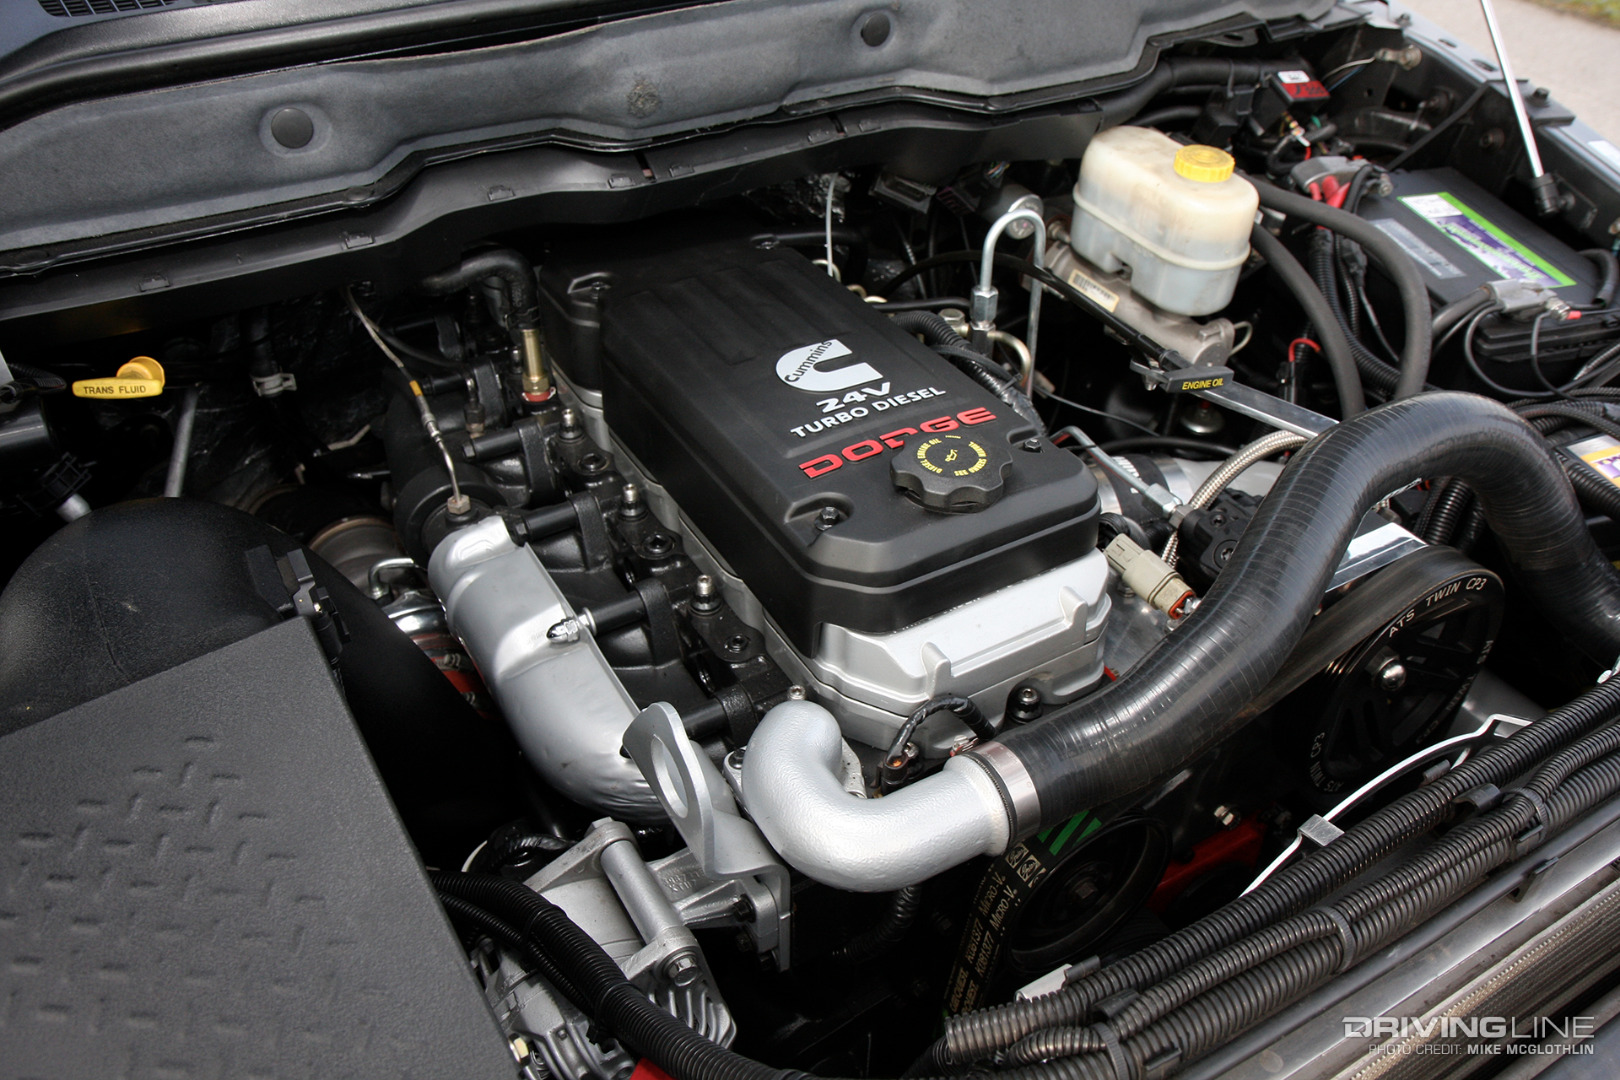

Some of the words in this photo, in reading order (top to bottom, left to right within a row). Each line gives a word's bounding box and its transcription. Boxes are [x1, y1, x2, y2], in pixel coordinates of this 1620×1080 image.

[784, 340, 833, 383] Cummins
[83, 386, 114, 395] TRANS
[118, 385, 146, 394] FLUID
[816, 381, 891, 414] 24V
[1182, 379, 1212, 390] ENGINE
[1212, 378, 1224, 387] OIL
[790, 406, 869, 438] TURBO
[872, 386, 947, 412] DIESEL
[799, 406, 997, 479] DODGE
[920, 458, 943, 474] DIESEL
[1389, 608, 1415, 638] ATS
[1426, 581, 1462, 607] TWIN
[1465, 577, 1488, 590] CP3
